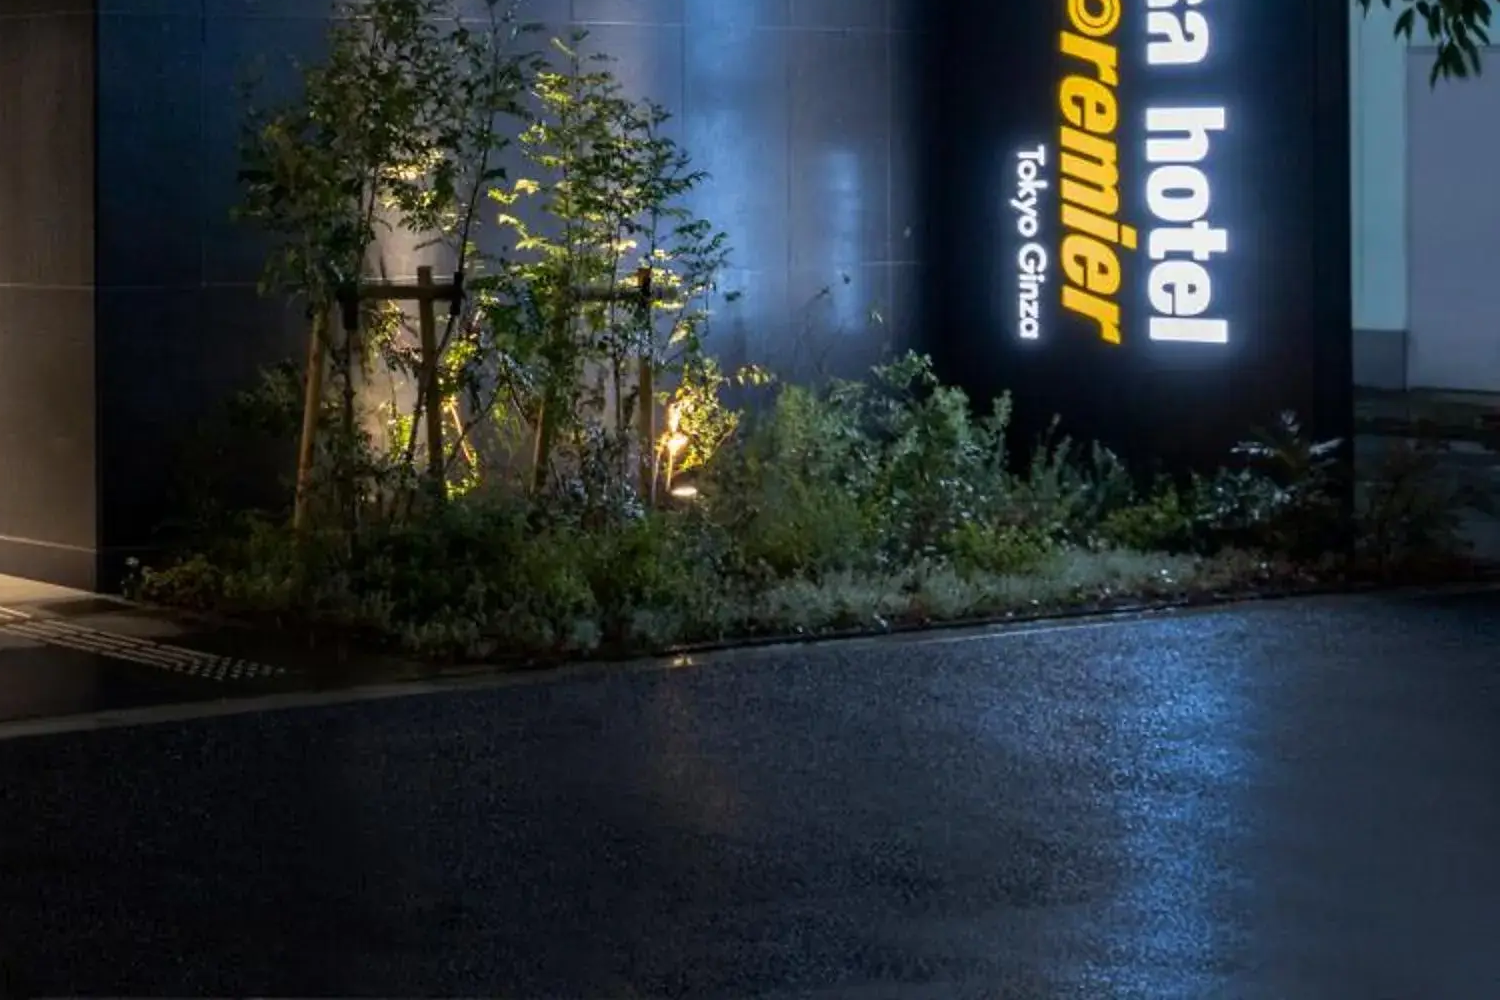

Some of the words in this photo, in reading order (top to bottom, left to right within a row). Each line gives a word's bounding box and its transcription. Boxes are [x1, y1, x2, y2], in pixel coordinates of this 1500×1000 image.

[1010, 145, 1048, 237] Tokyo
[1145, 106, 1228, 343] hotel
[1017, 242, 1047, 340] Ginza
